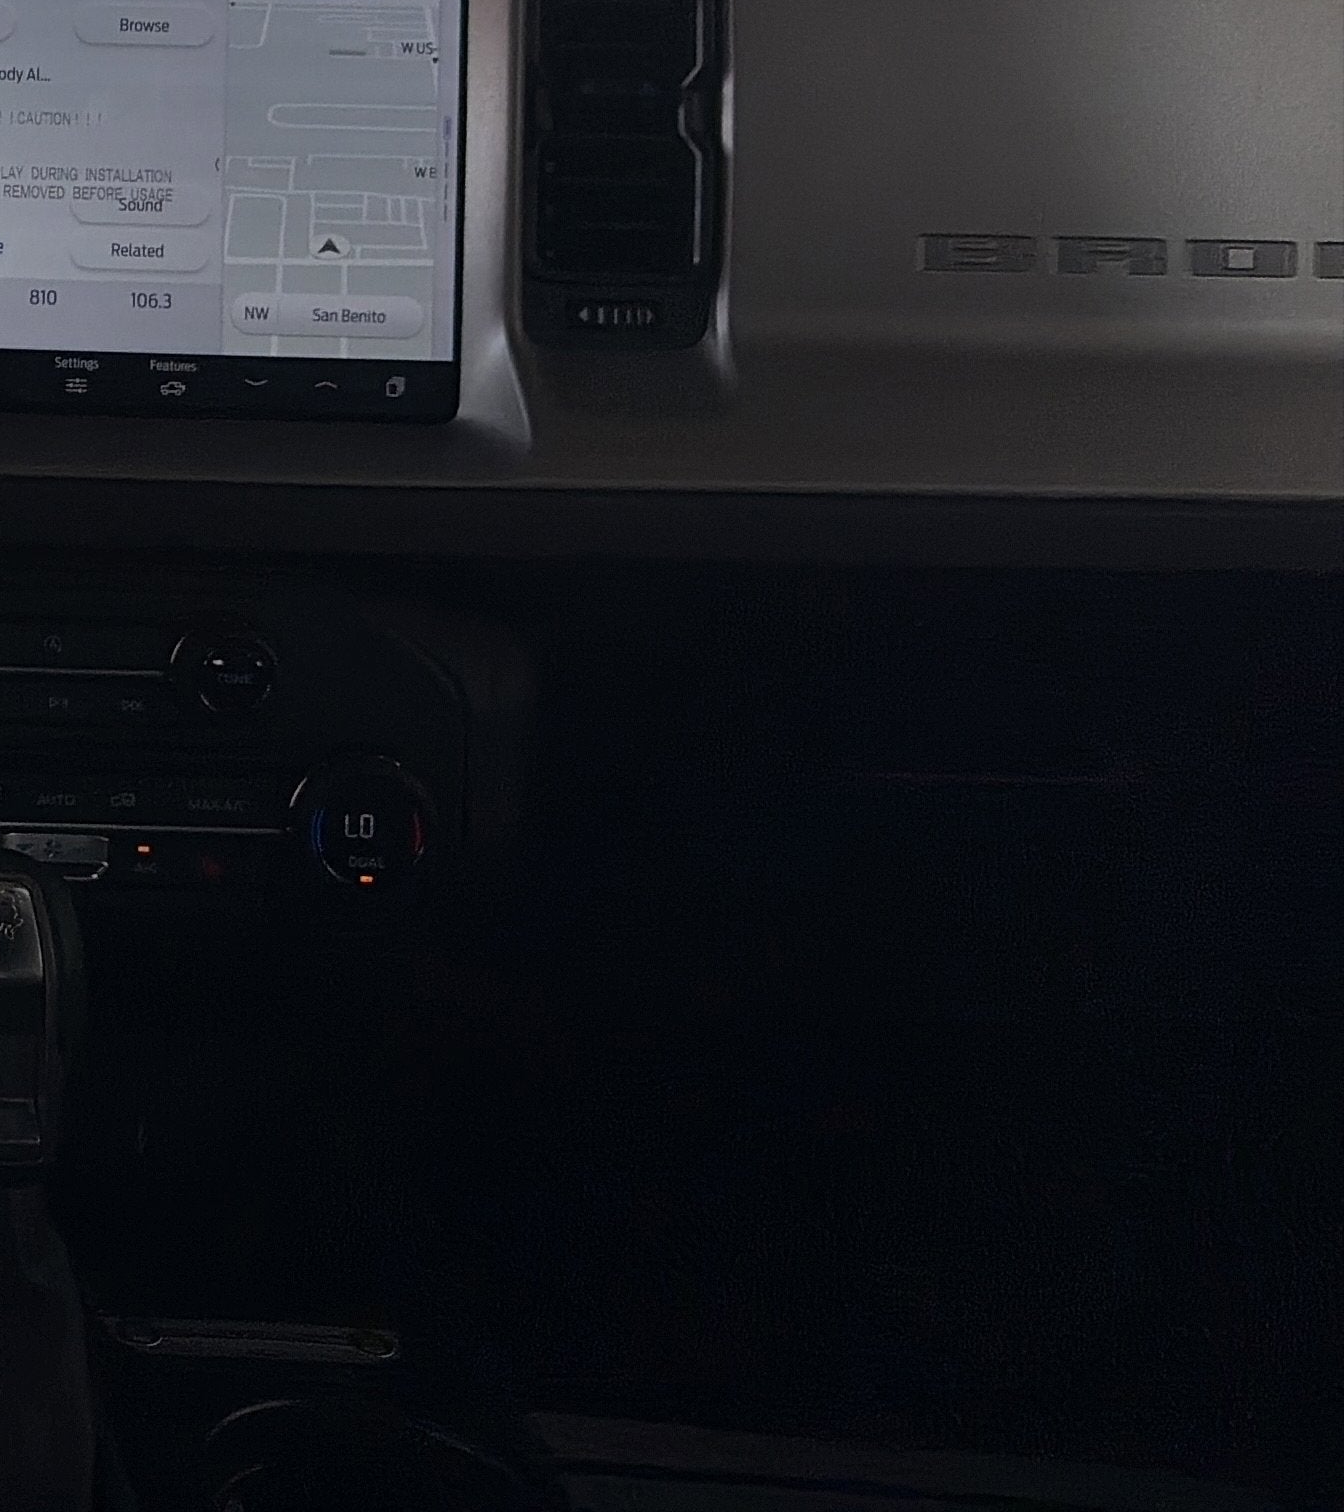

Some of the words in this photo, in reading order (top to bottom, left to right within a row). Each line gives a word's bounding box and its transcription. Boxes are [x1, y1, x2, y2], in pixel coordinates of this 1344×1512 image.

[119, 18, 170, 34] Browse
[401, 42, 413, 54] W
[17, 112, 71, 126] CAUTION
[31, 167, 78, 181] DURING
[85, 169, 173, 184] INSTALLATION
[3, 185, 65, 199] REMOVED
[72, 186, 123, 201] BEFORE
[130, 187, 173, 202] USAGE
[118, 199, 163, 212] Sound
[111, 242, 165, 258] Related
[918, 233, 1343, 279] BRO
[29, 290, 58, 306] 810
[130, 292, 172, 310] 106.3
[244, 307, 270, 321] NW
[312, 309, 339, 323] San
[341, 310, 386, 324] Benito
[54, 357, 99, 370] Settings
[150, 360, 197, 372] Features
[344, 813, 374, 839] LO
